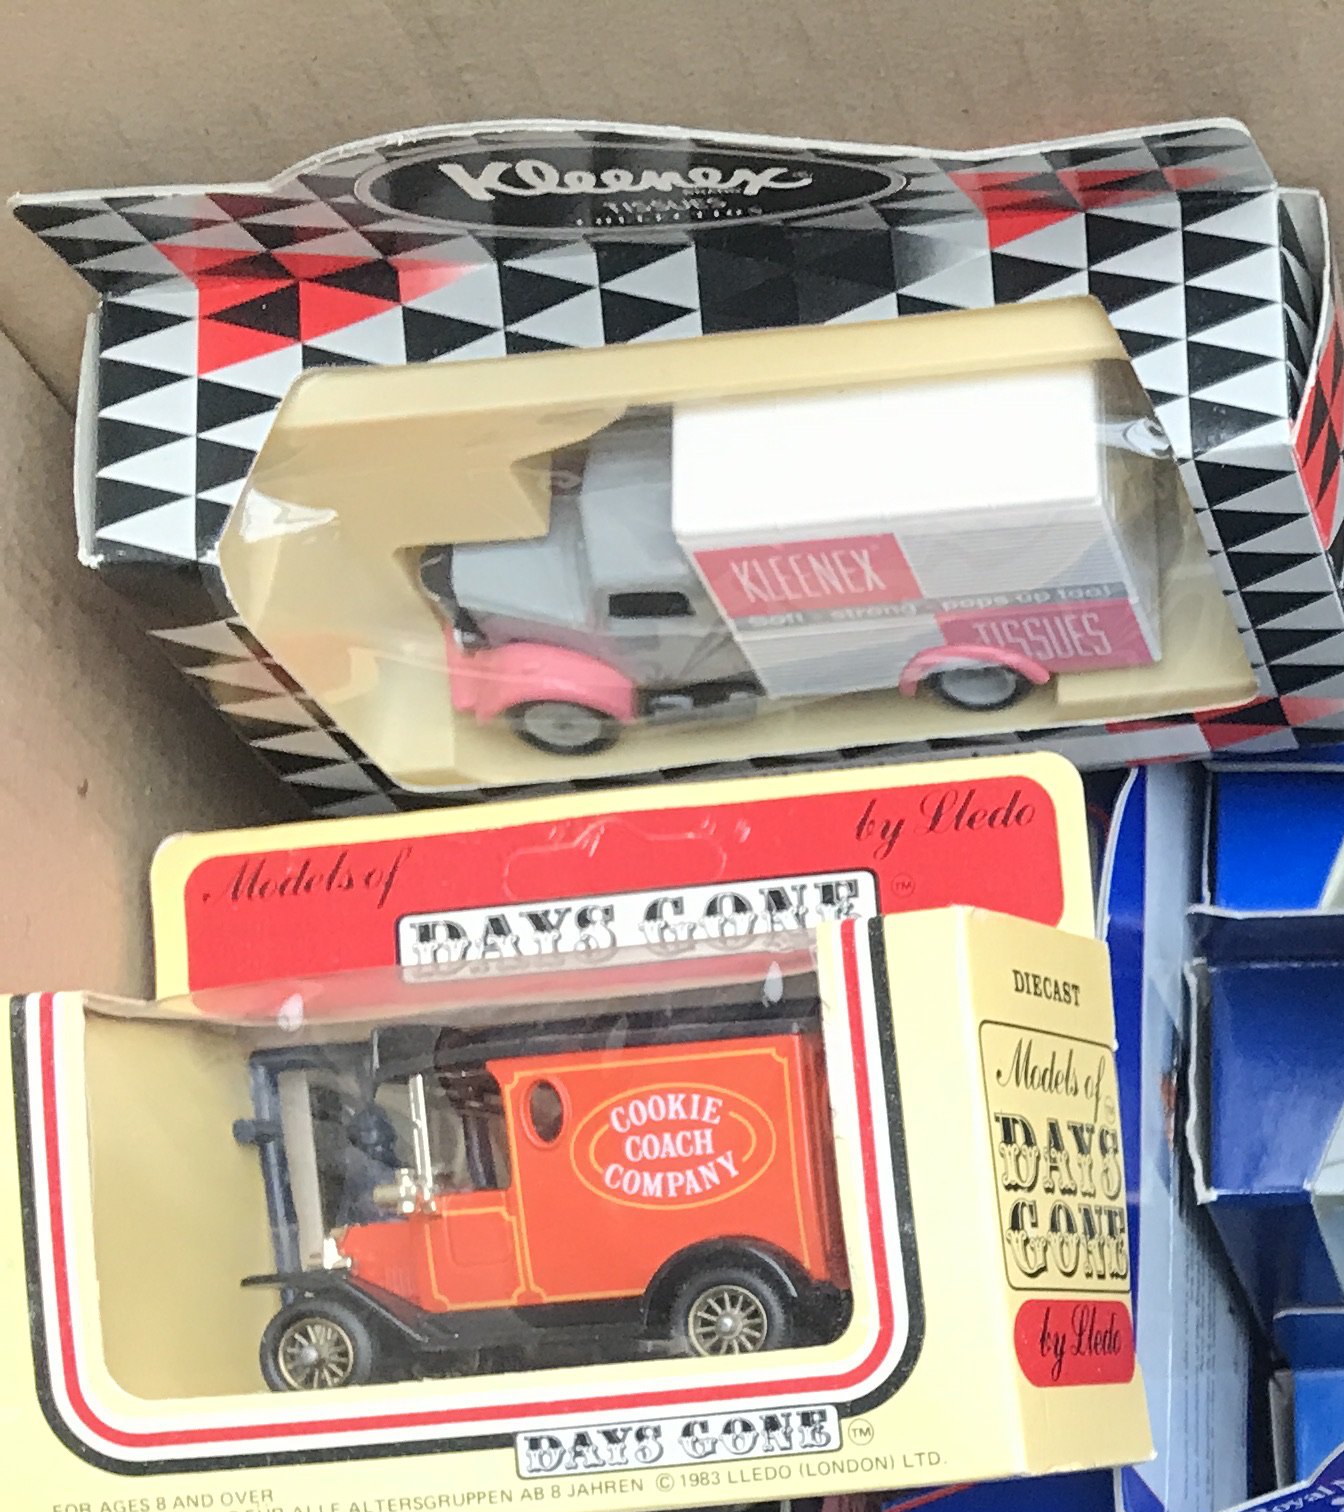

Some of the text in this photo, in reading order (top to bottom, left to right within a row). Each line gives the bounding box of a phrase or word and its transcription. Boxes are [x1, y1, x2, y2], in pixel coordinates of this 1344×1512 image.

[731, 548, 887, 603] KLEENEX
[975, 612, 1112, 659] TISSUES
[856, 787, 1037, 859] by Lledo
[203, 847, 412, 908] Models of
[410, 878, 859, 977] DAYS GONE
[1012, 969, 1081, 1007] DIECAST
[996, 1038, 1079, 1098] Models
[1083, 1062, 1104, 1124] of
[609, 1092, 724, 1133] COOKIE
[625, 1127, 714, 1161] COACH
[994, 1112, 1120, 1198] DAYS
[603, 1153, 739, 1199] COMPANY
[1005, 1199, 1129, 1280] GONE
[1039, 1306, 1122, 1381] by Lledo
[523, 1421, 665, 1474] DAYS
[678, 1409, 833, 1461] GONE
[156, 1495, 168, 1511] 8
[172, 1492, 215, 1511] AND
[219, 1488, 274, 1508] OVER
[520, 1486, 546, 1503] AB
[549, 1484, 562, 1500] 8
[566, 1476, 645, 1499] JAHREN
[679, 1467, 722, 1488] 1983
[728, 1462, 792, 1485] LLEDO
[798, 1455, 897, 1480] (LONDON)
[902, 1450, 948, 1471] LTD.
